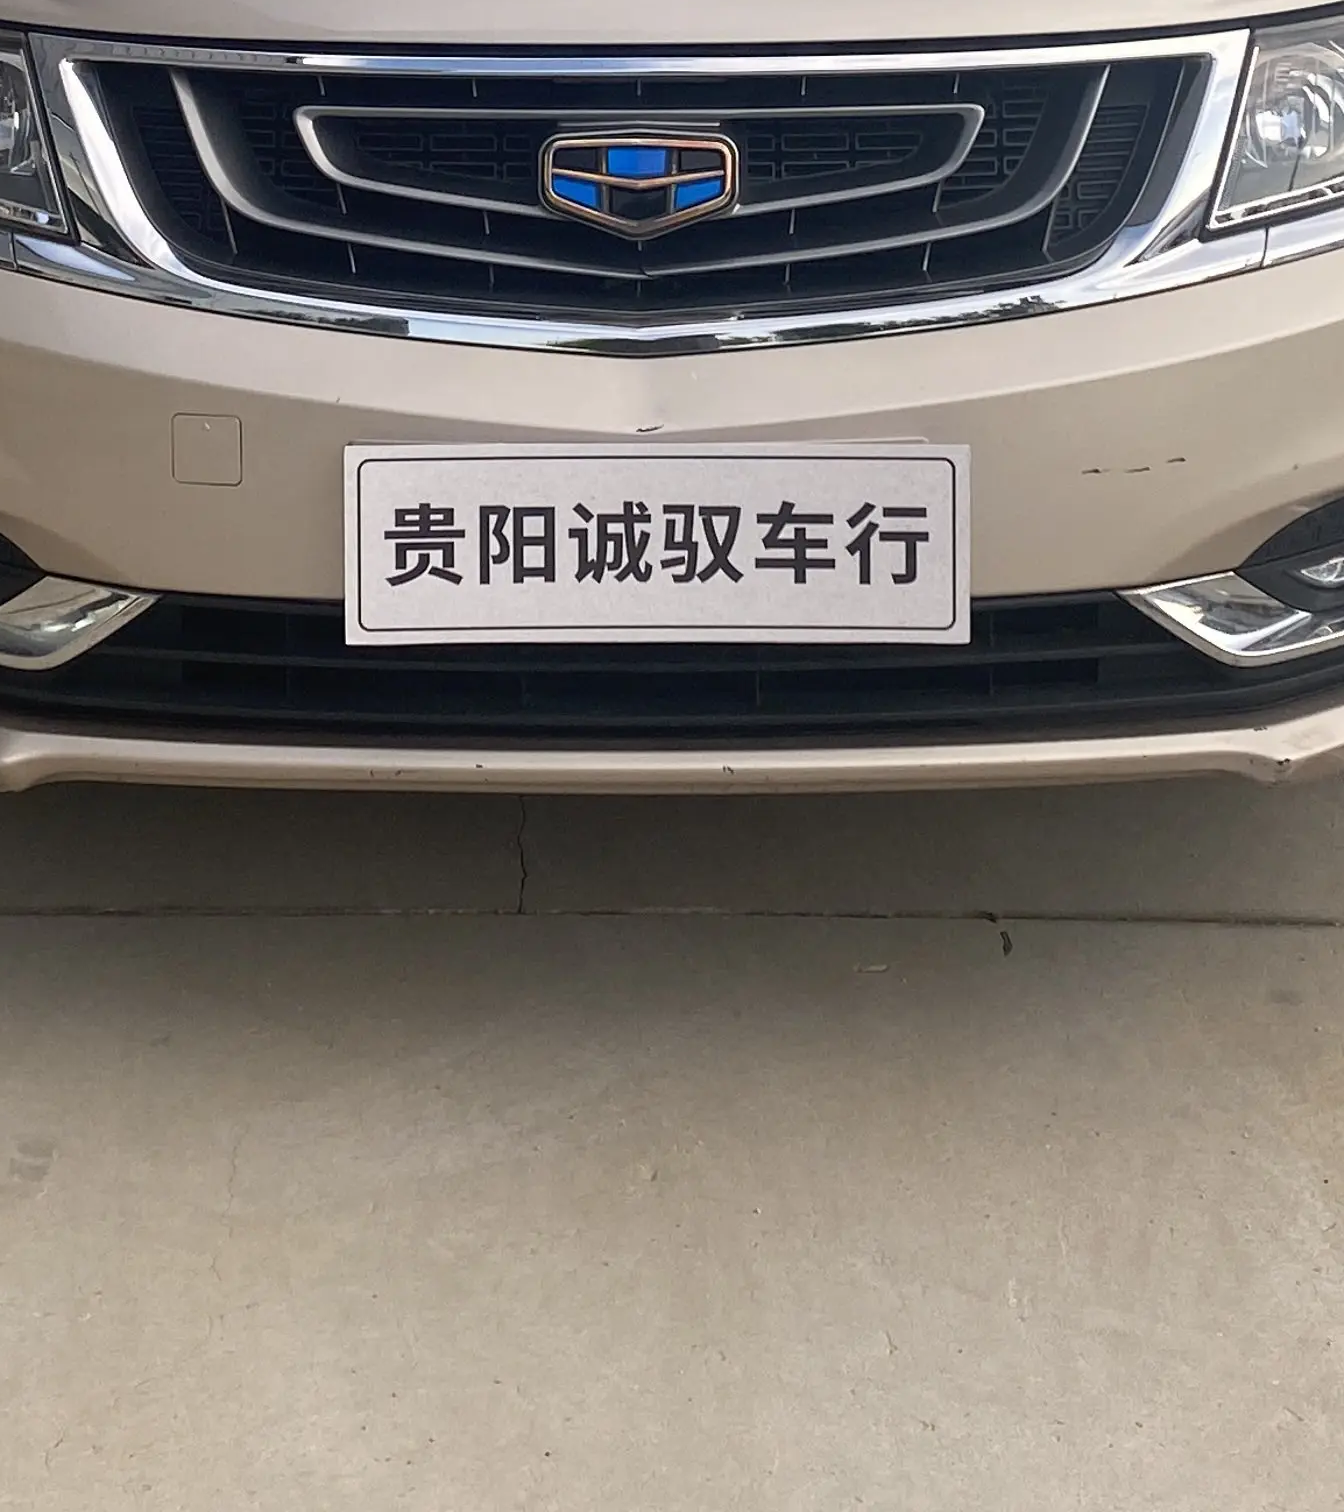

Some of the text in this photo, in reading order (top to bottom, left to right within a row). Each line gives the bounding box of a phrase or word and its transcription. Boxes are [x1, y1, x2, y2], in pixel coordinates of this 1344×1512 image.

[382, 500, 931, 586] 贵阳诚驭车行
